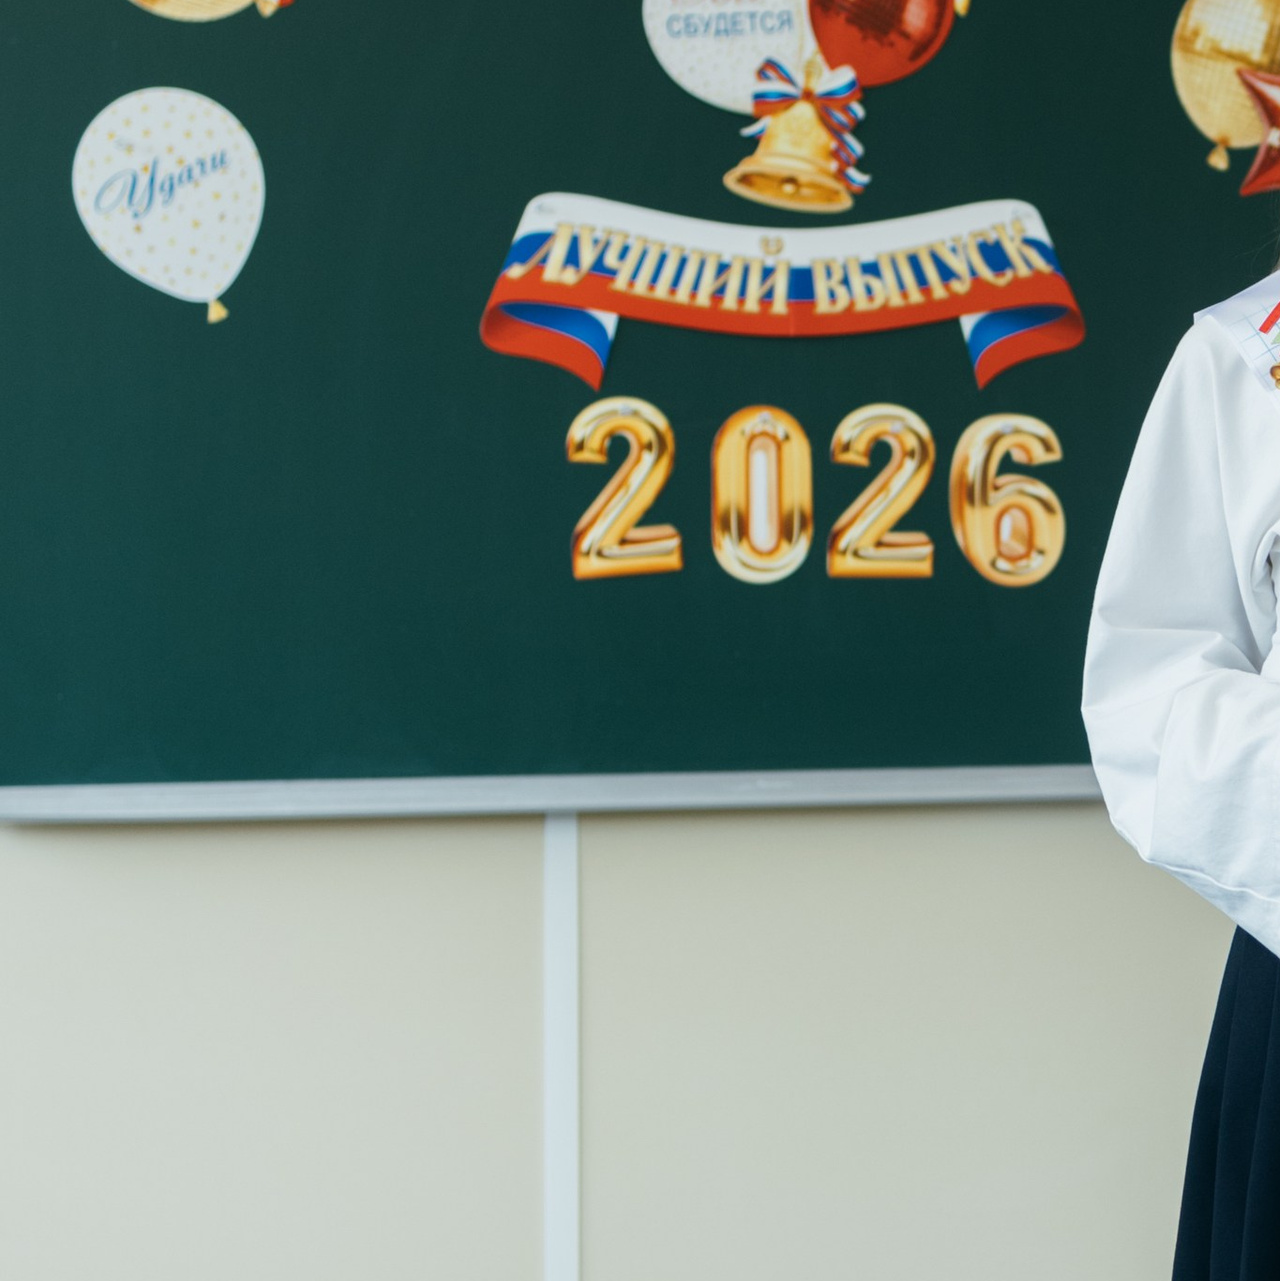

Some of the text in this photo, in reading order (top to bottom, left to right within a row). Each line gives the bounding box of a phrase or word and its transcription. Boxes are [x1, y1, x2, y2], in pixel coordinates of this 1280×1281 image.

[666, 8, 795, 40] СБУДЕТСЯ
[506, 218, 1054, 315] ЛУЧШИЙ ВЫПУСК
[566, 396, 1067, 588] 2026
